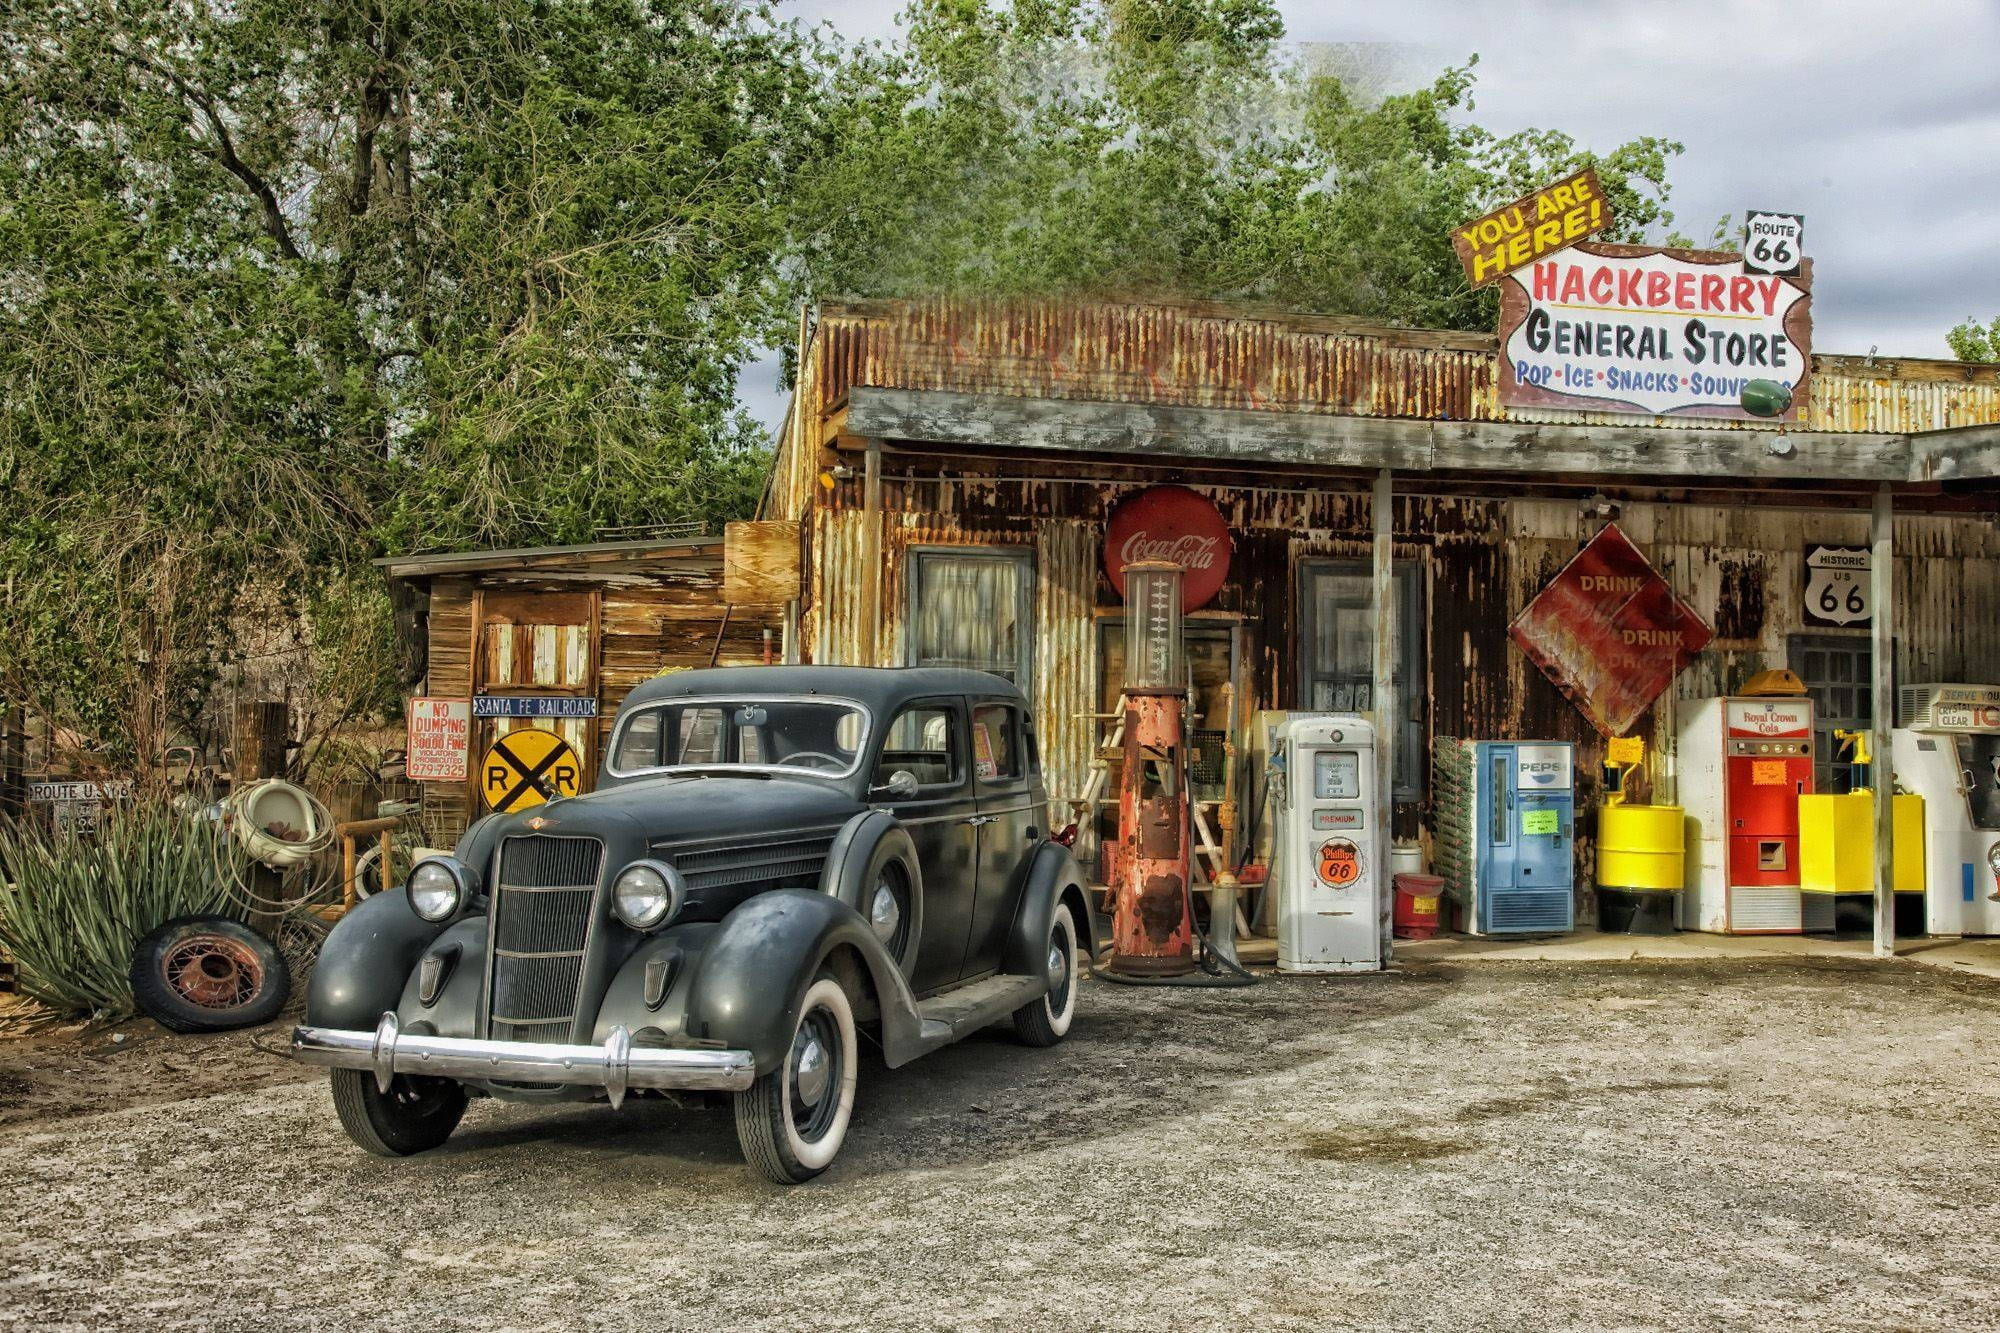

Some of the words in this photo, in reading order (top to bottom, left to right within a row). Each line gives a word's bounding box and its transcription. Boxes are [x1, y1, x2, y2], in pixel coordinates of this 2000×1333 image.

[1462, 207, 1524, 251] YOU
[1537, 176, 1594, 221] ARE
[1753, 222, 1796, 238] ROUTE
[1473, 198, 1602, 282] HERE!
[1753, 238, 1792, 263] 66
[1533, 261, 1782, 316] HACKBERRY
[1526, 308, 1673, 361] GENERAL
[1683, 319, 1787, 367] STORE
[1516, 360, 1552, 384] POP
[1564, 363, 1594, 388] ICE
[1606, 365, 1679, 394] SNACKS
[1820, 555, 1865, 566] HISTORIC
[1580, 575, 1643, 591] DRINK
[1820, 583, 1865, 613] 66
[1622, 629, 1685, 646] DRINK
[1944, 690, 1977, 701] SERVE
[433, 703, 449, 717] NO
[478, 698, 512, 715] SANTA
[519, 698, 532, 714] FE
[538, 699, 592, 715] RAILROAD
[415, 717, 466, 733] DUMPING
[1744, 711, 1768, 725] Royal
[1770, 712, 1798, 722] Crown
[1942, 716, 1969, 727] CLEAR
[1759, 723, 1780, 733] Cola
[447, 738, 467, 750] FINE
[412, 764, 464, 776] 979-7325
[488, 766, 509, 791] R
[555, 766, 576, 791] R
[34, 785, 77, 799] ROUTE
[1319, 815, 1356, 823] PREMIUM
[1324, 846, 1354, 861] Phillips
[1328, 863, 1351, 878] 66
